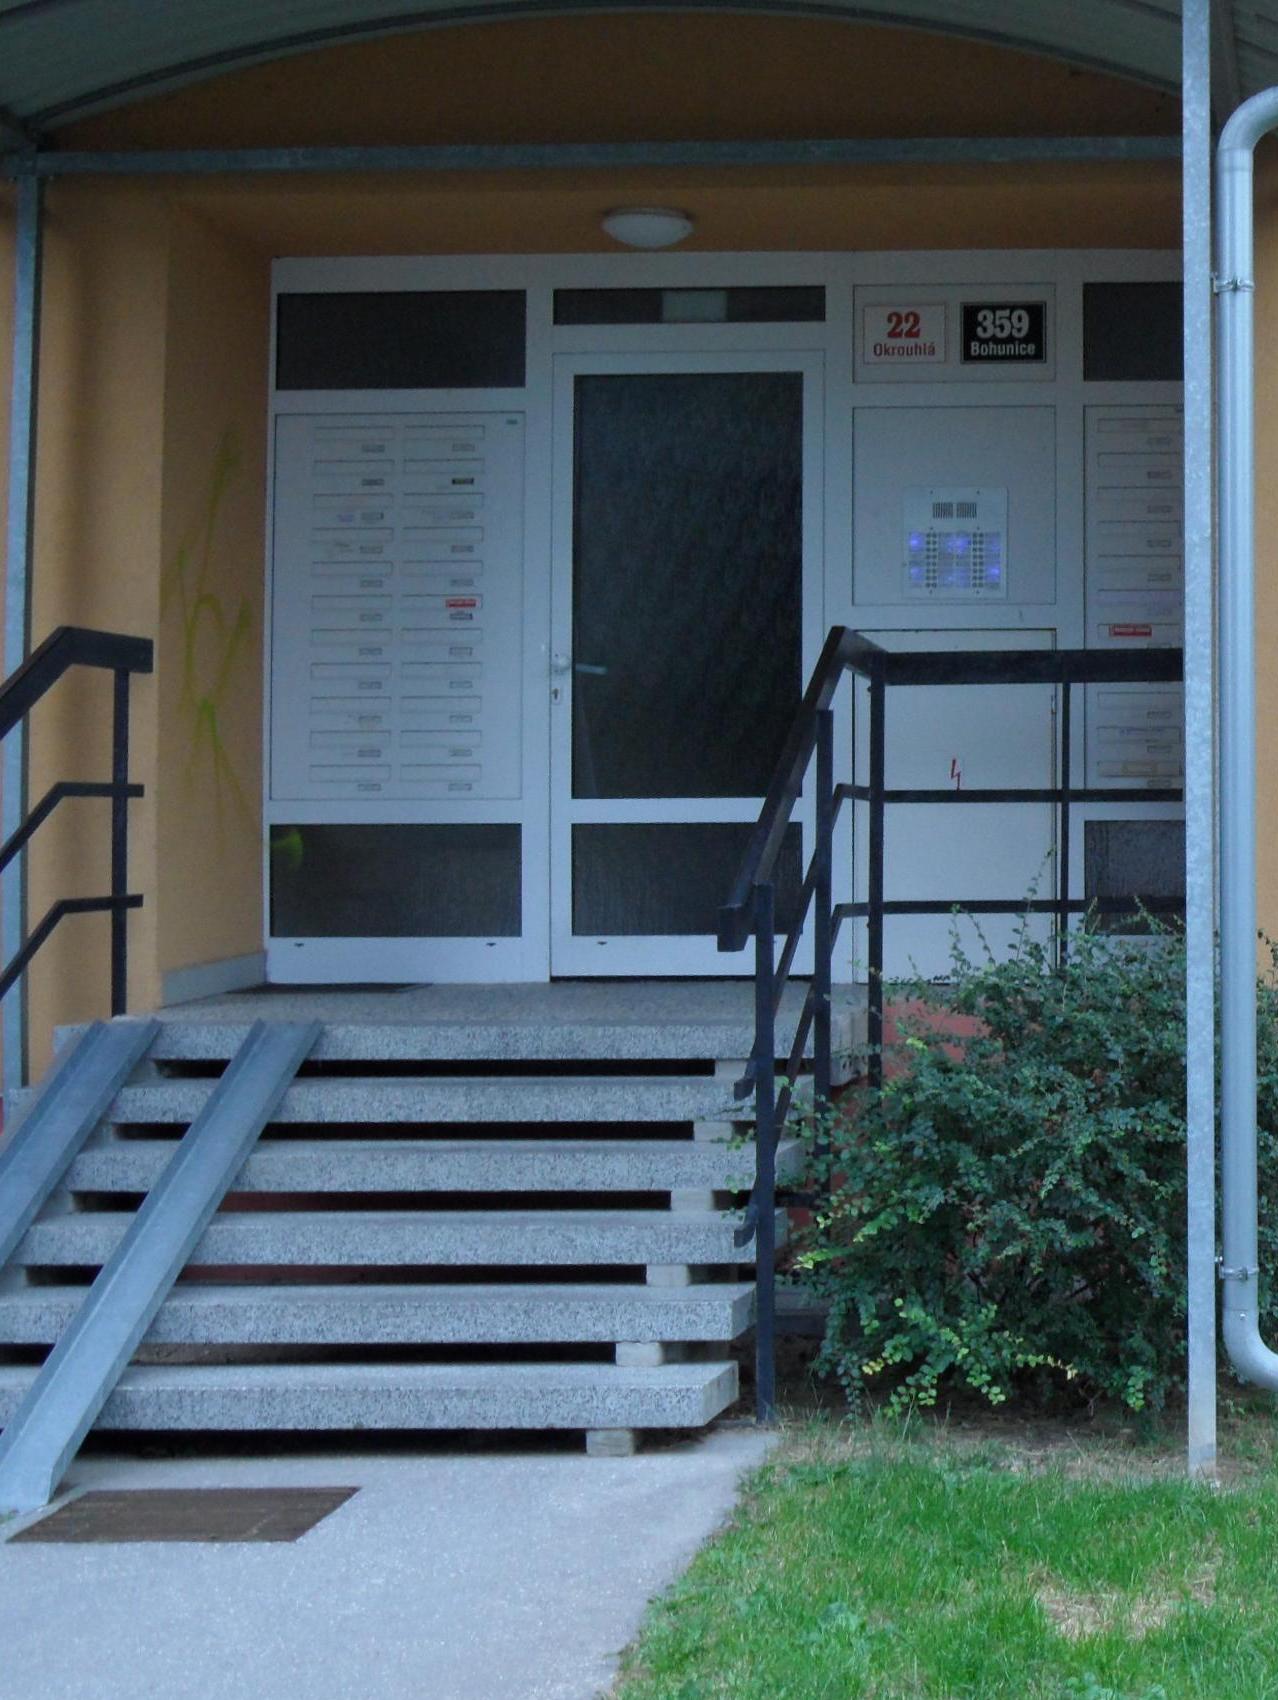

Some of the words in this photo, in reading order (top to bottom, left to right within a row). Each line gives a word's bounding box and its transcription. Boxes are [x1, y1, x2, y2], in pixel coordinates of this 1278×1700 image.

[886, 311, 921, 339] 22
[976, 309, 1030, 339] 359
[872, 342, 936, 358] Okrouhlá
[970, 341, 1036, 356] Bohunice
